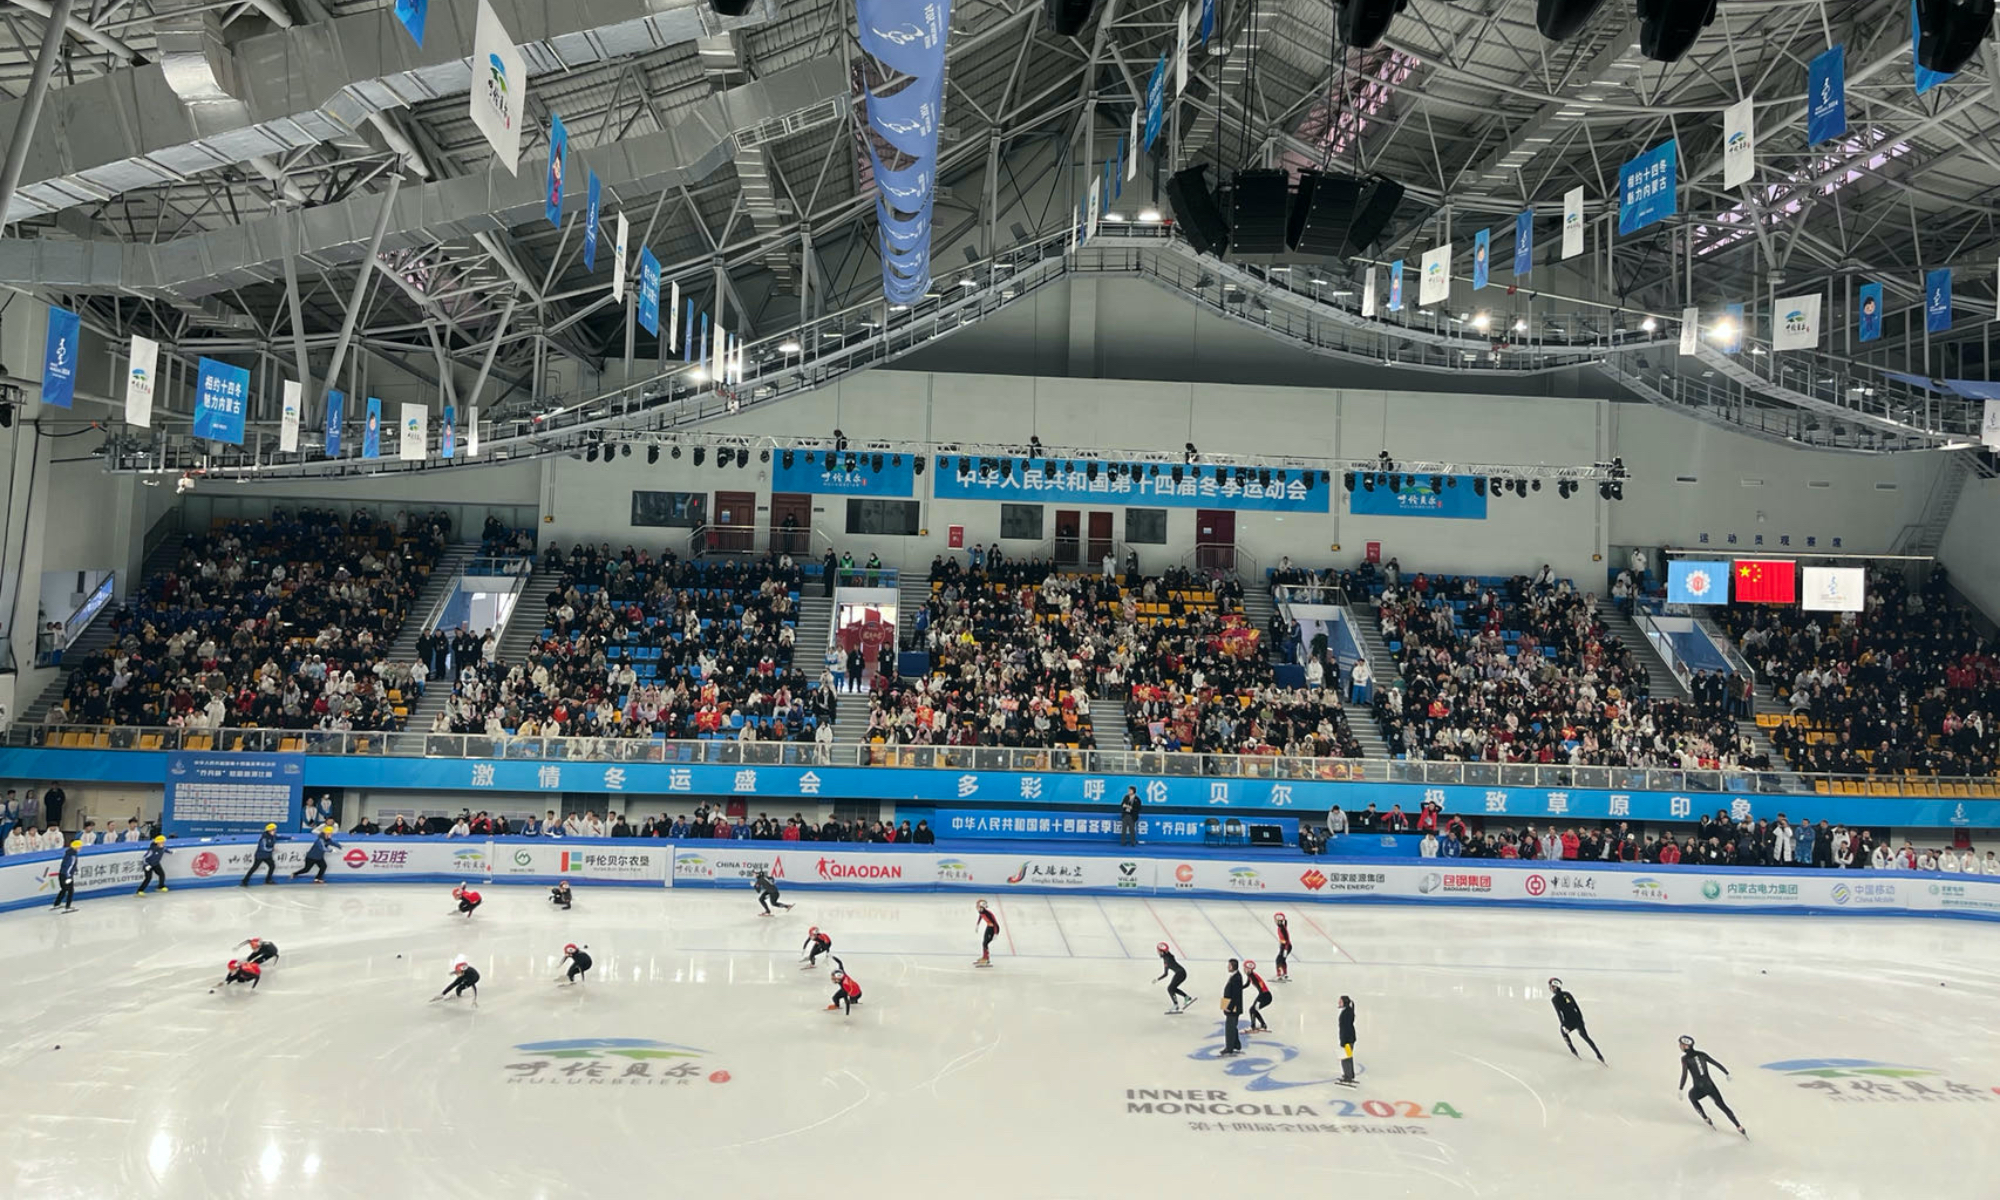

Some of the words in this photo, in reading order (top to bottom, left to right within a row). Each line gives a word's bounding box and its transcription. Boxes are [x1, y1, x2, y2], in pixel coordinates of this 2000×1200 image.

[1627, 159, 1668, 189] 相约十四冬
[1626, 176, 1667, 206] 魅力内蒙古
[204, 375, 242, 398] 相约十四冬
[203, 392, 241, 415] 魅力内蒙古
[956, 469, 1308, 501] 中华人民共和国第十四届冬季运动会
[471, 763, 822, 795] 激情冬运盛会
[957, 773, 1294, 806] 多彩呼伦贝尔
[1424, 788, 1752, 820] 极致草原印象
[952, 816, 1149, 835] 中华人民共和国第十四届冬季运会
[370, 849, 408, 864] 迈胜
[585, 854, 650, 867] 呼伦贝尔农垦
[117, 874, 144, 883] LOTTER
[830, 864, 902, 879] QIAODAN
[1330, 872, 1385, 883] 国家能源集团
[1727, 883, 1798, 895] 内蒙古电力集团
[1854, 884, 1896, 896] 中国移动
[506, 1078, 693, 1086] HULUNBEIER
[1126, 1088, 1230, 1101] INNER
[1127, 1102, 1319, 1117] MONGOLIA
[1328, 1100, 1464, 1119] 2024
